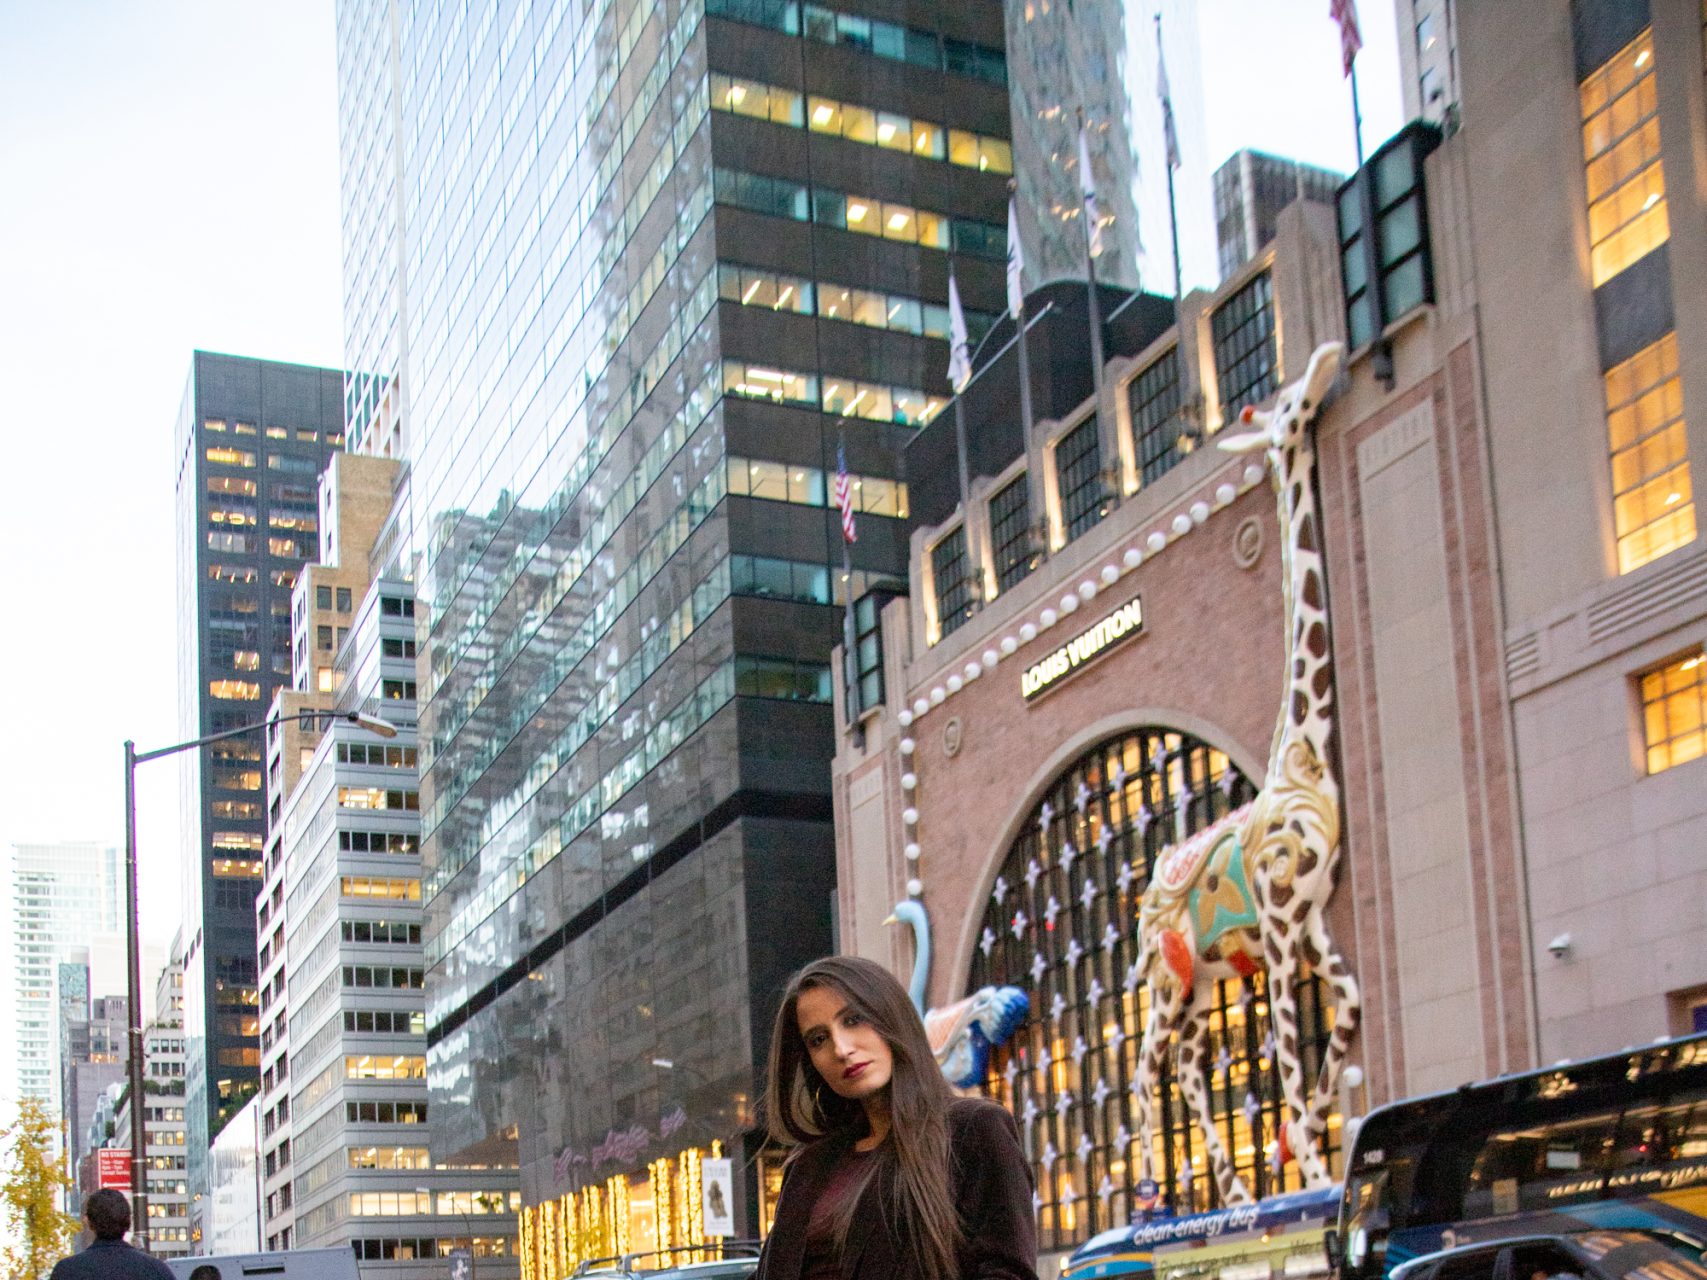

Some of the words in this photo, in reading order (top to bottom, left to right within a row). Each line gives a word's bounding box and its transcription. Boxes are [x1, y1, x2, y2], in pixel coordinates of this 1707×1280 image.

[1021, 648, 1070, 698] LOUIS
[1067, 598, 1142, 667] VUITTON
[1133, 1213, 1228, 1246] clean-energy
[1229, 1205, 1260, 1228] bus
